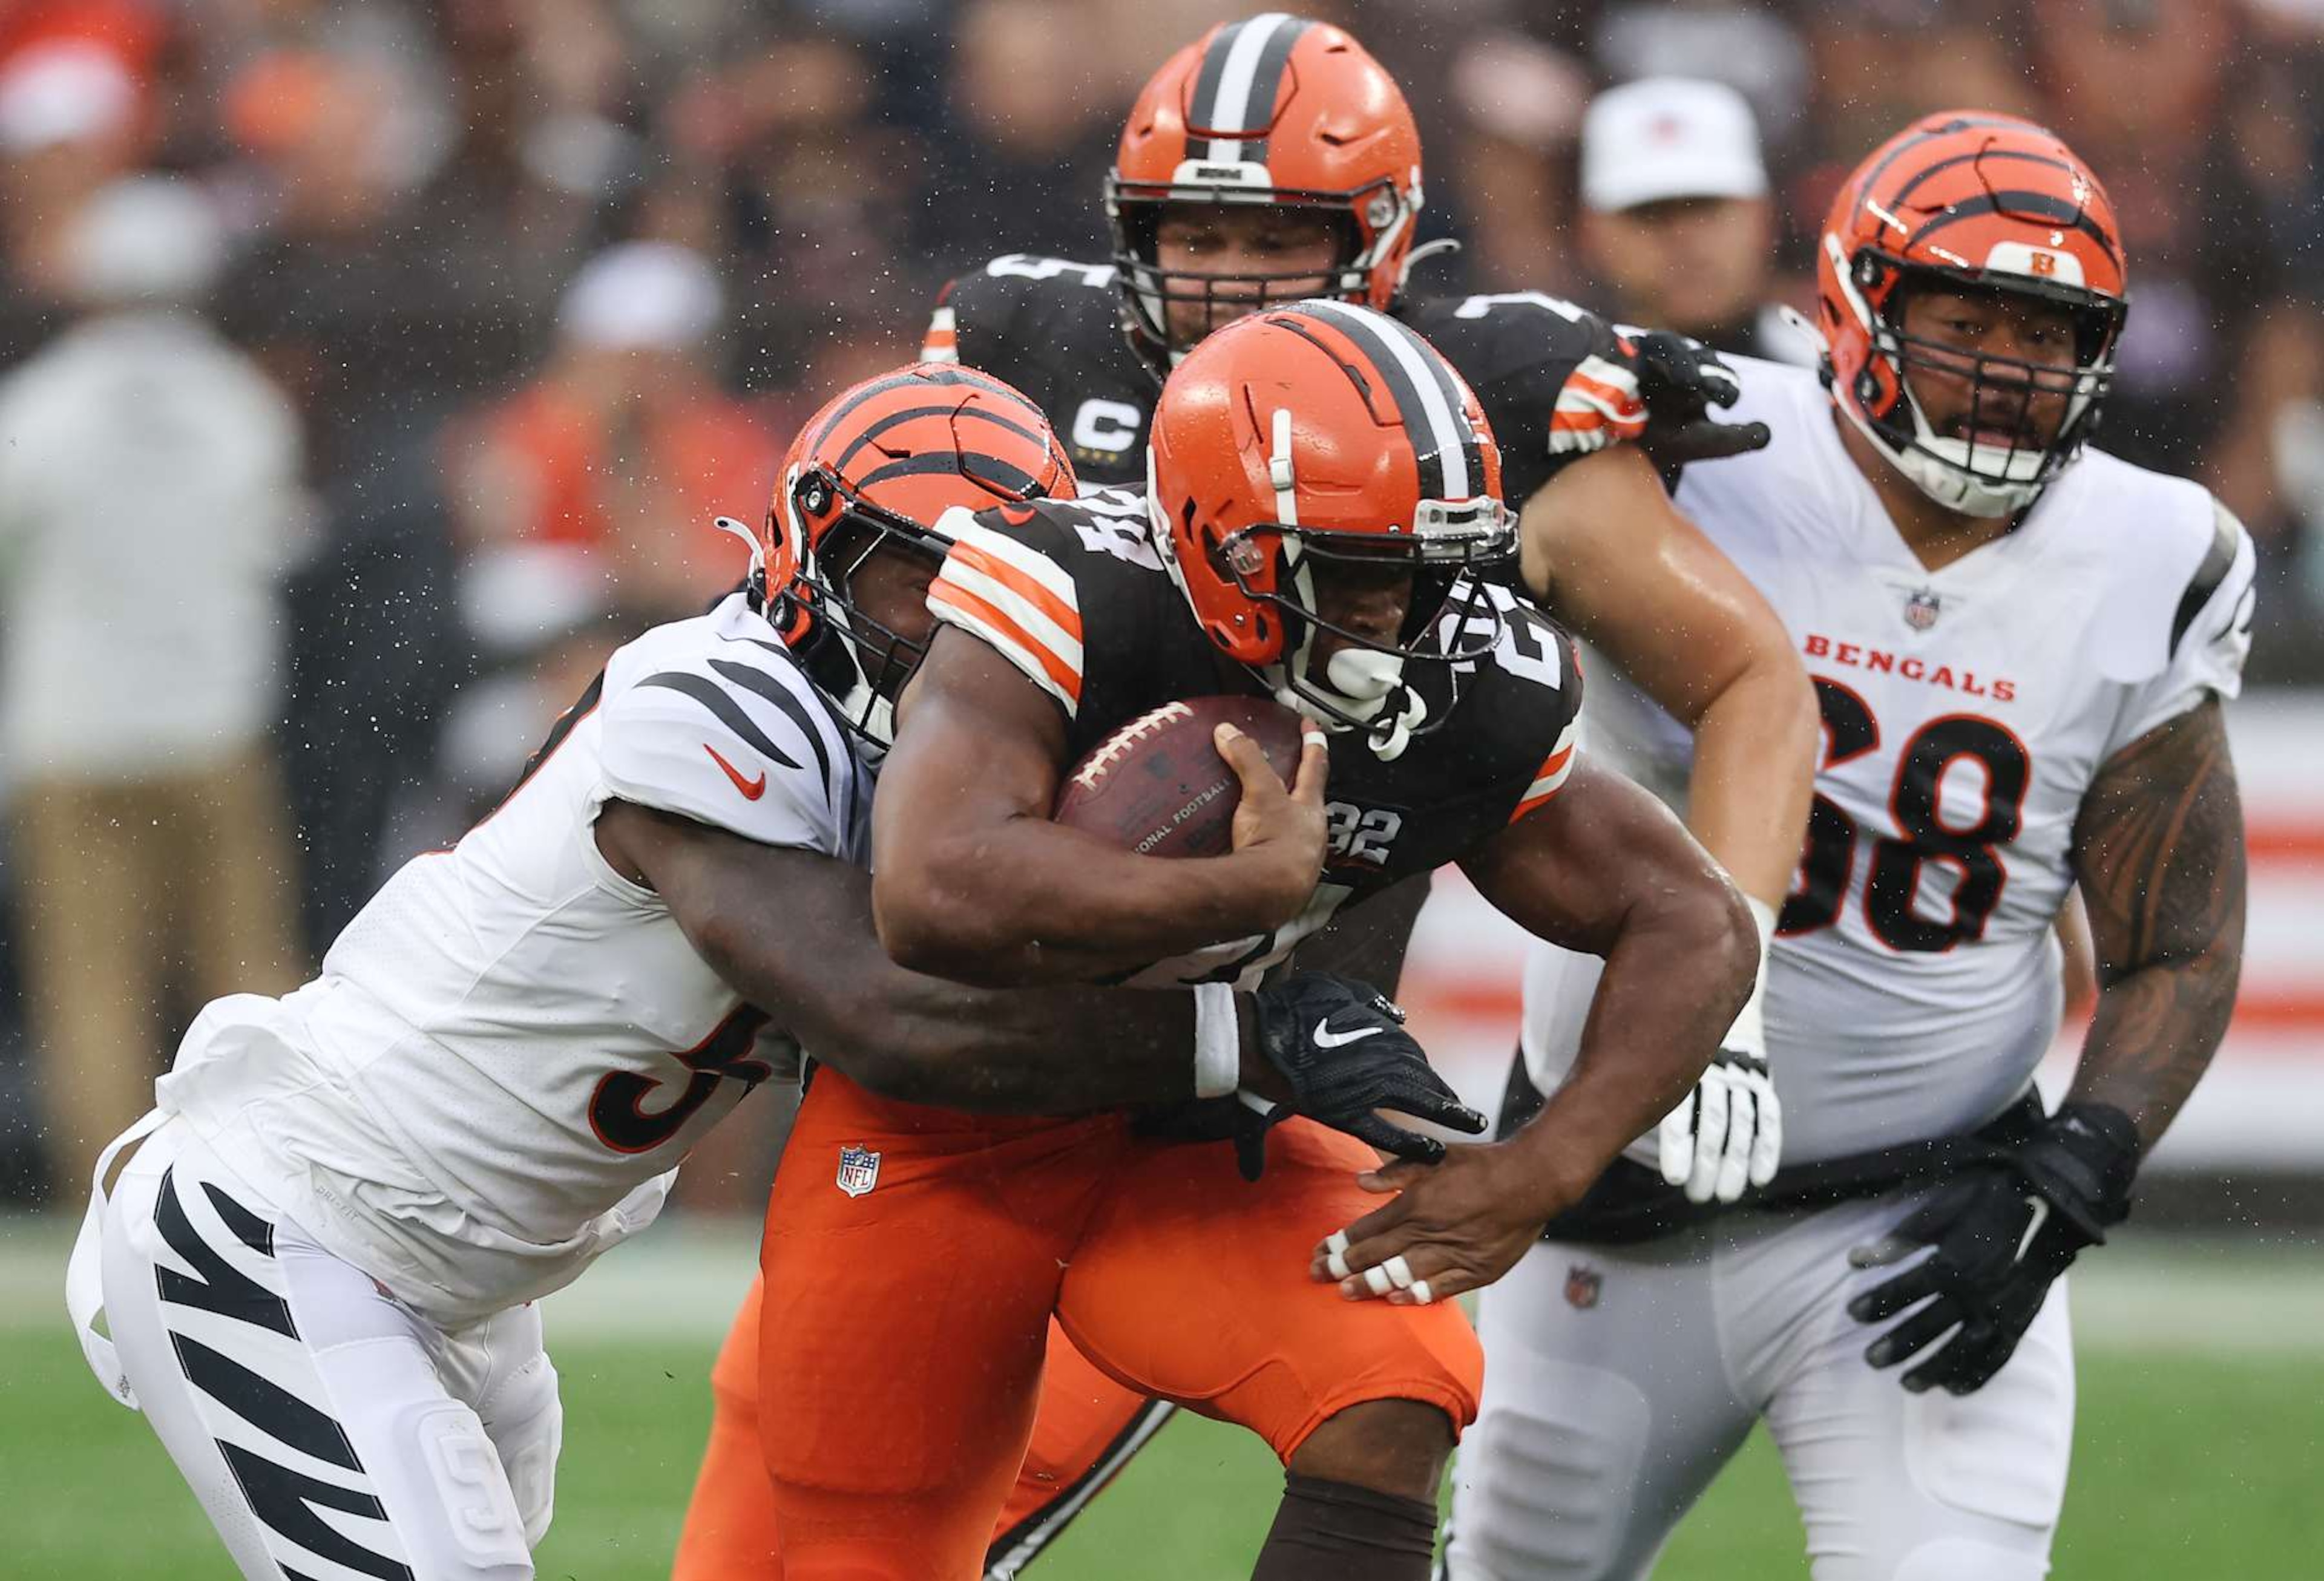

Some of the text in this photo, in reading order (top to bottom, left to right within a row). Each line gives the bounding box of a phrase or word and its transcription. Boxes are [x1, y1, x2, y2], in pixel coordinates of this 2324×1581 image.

[1073, 399, 1141, 451] C
[1804, 634, 2015, 702] BENGALS
[1134, 825, 1172, 854] ONAL
[844, 1166, 868, 1187] NFL
